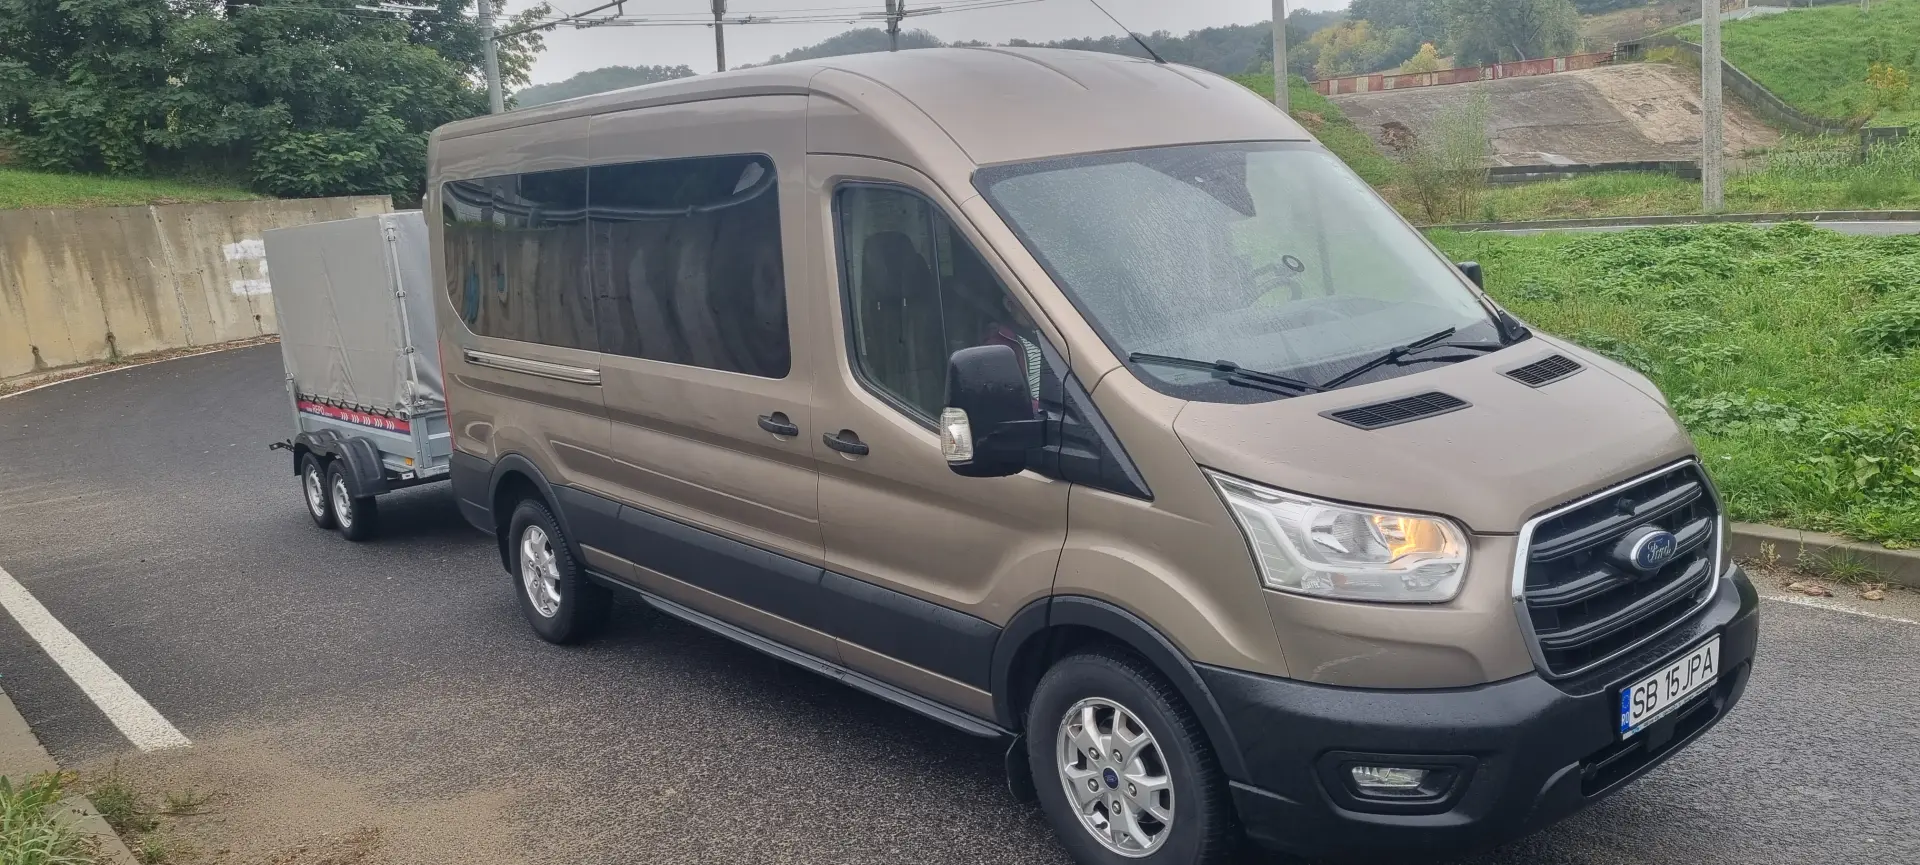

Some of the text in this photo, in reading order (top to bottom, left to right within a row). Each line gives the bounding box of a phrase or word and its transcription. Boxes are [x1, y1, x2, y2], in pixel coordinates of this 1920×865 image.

[1647, 538, 1671, 563] Ford
[1633, 679, 1658, 719] SB
[1665, 666, 1680, 700] 15
[1682, 647, 1713, 691] JPA
[1621, 711, 1630, 726] RO
